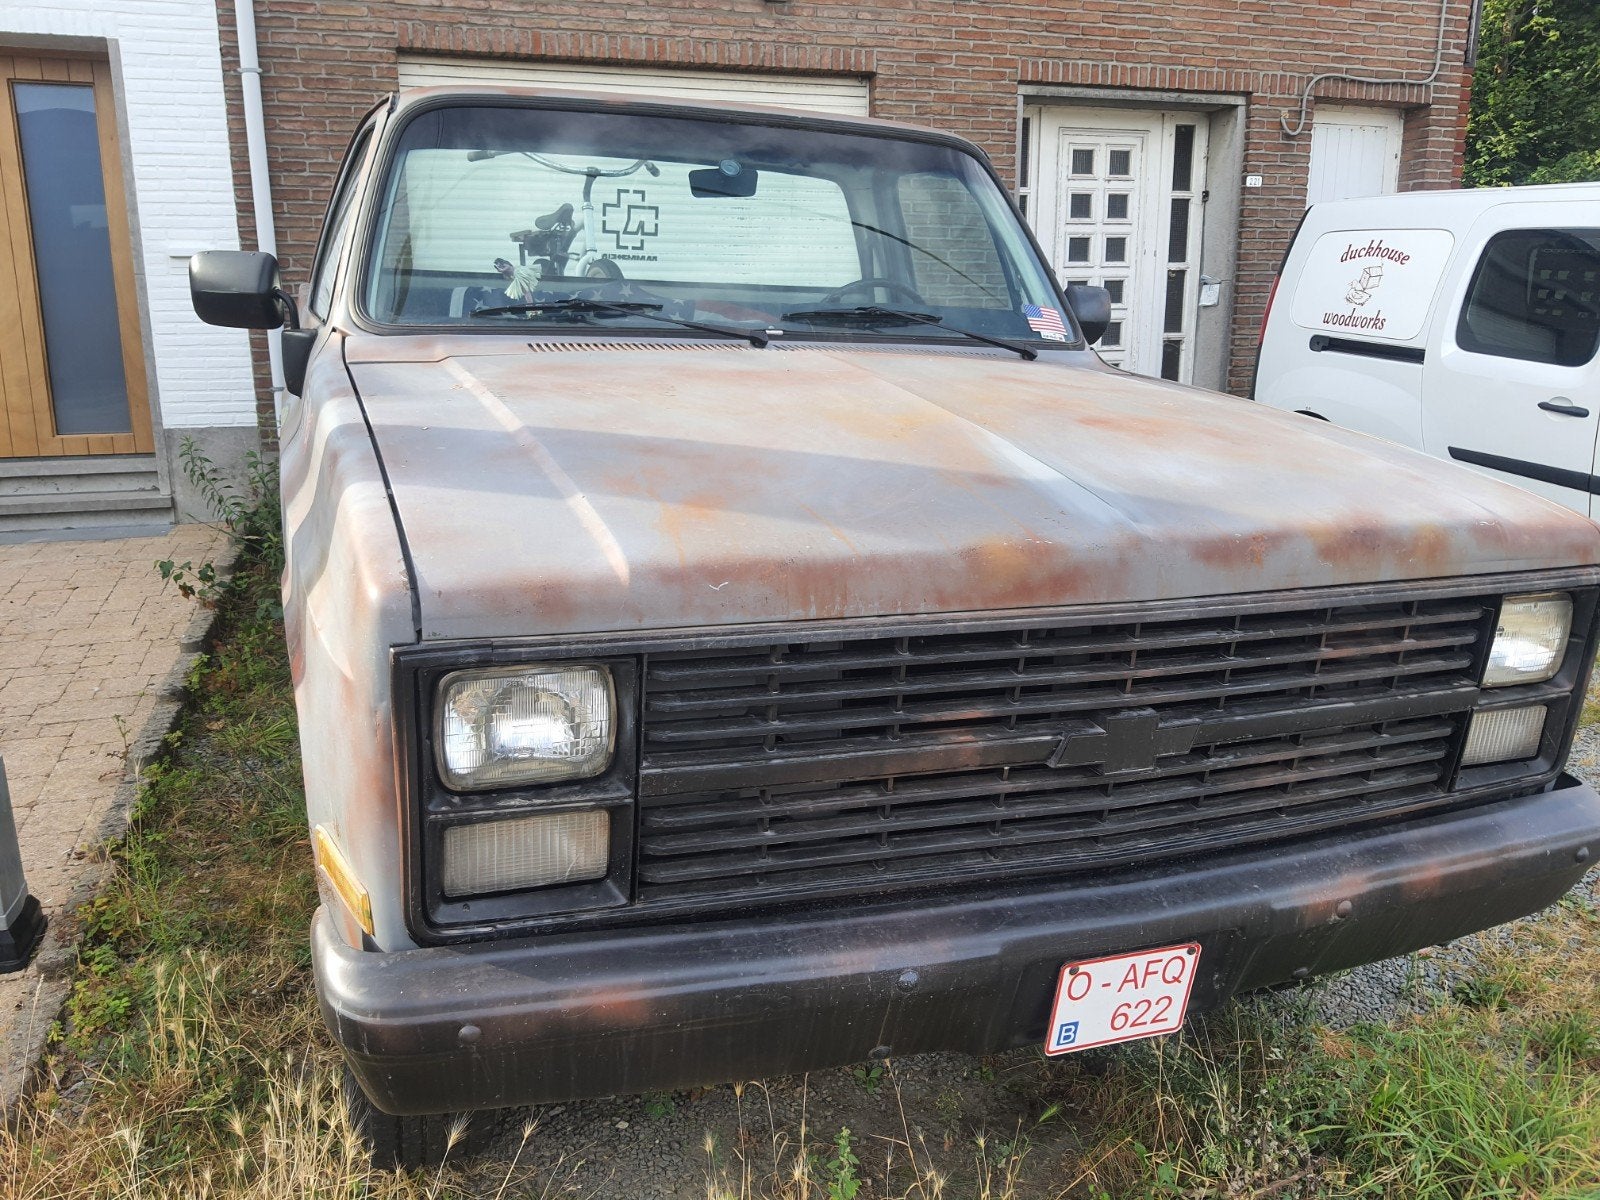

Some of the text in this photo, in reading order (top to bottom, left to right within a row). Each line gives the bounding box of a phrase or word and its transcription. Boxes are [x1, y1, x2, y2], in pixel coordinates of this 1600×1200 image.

[1340, 239, 1411, 266] duckhouse
[1322, 307, 1387, 331] woodworks
[1110, 995, 1173, 1031] 622
[1059, 1024, 1076, 1045] B
